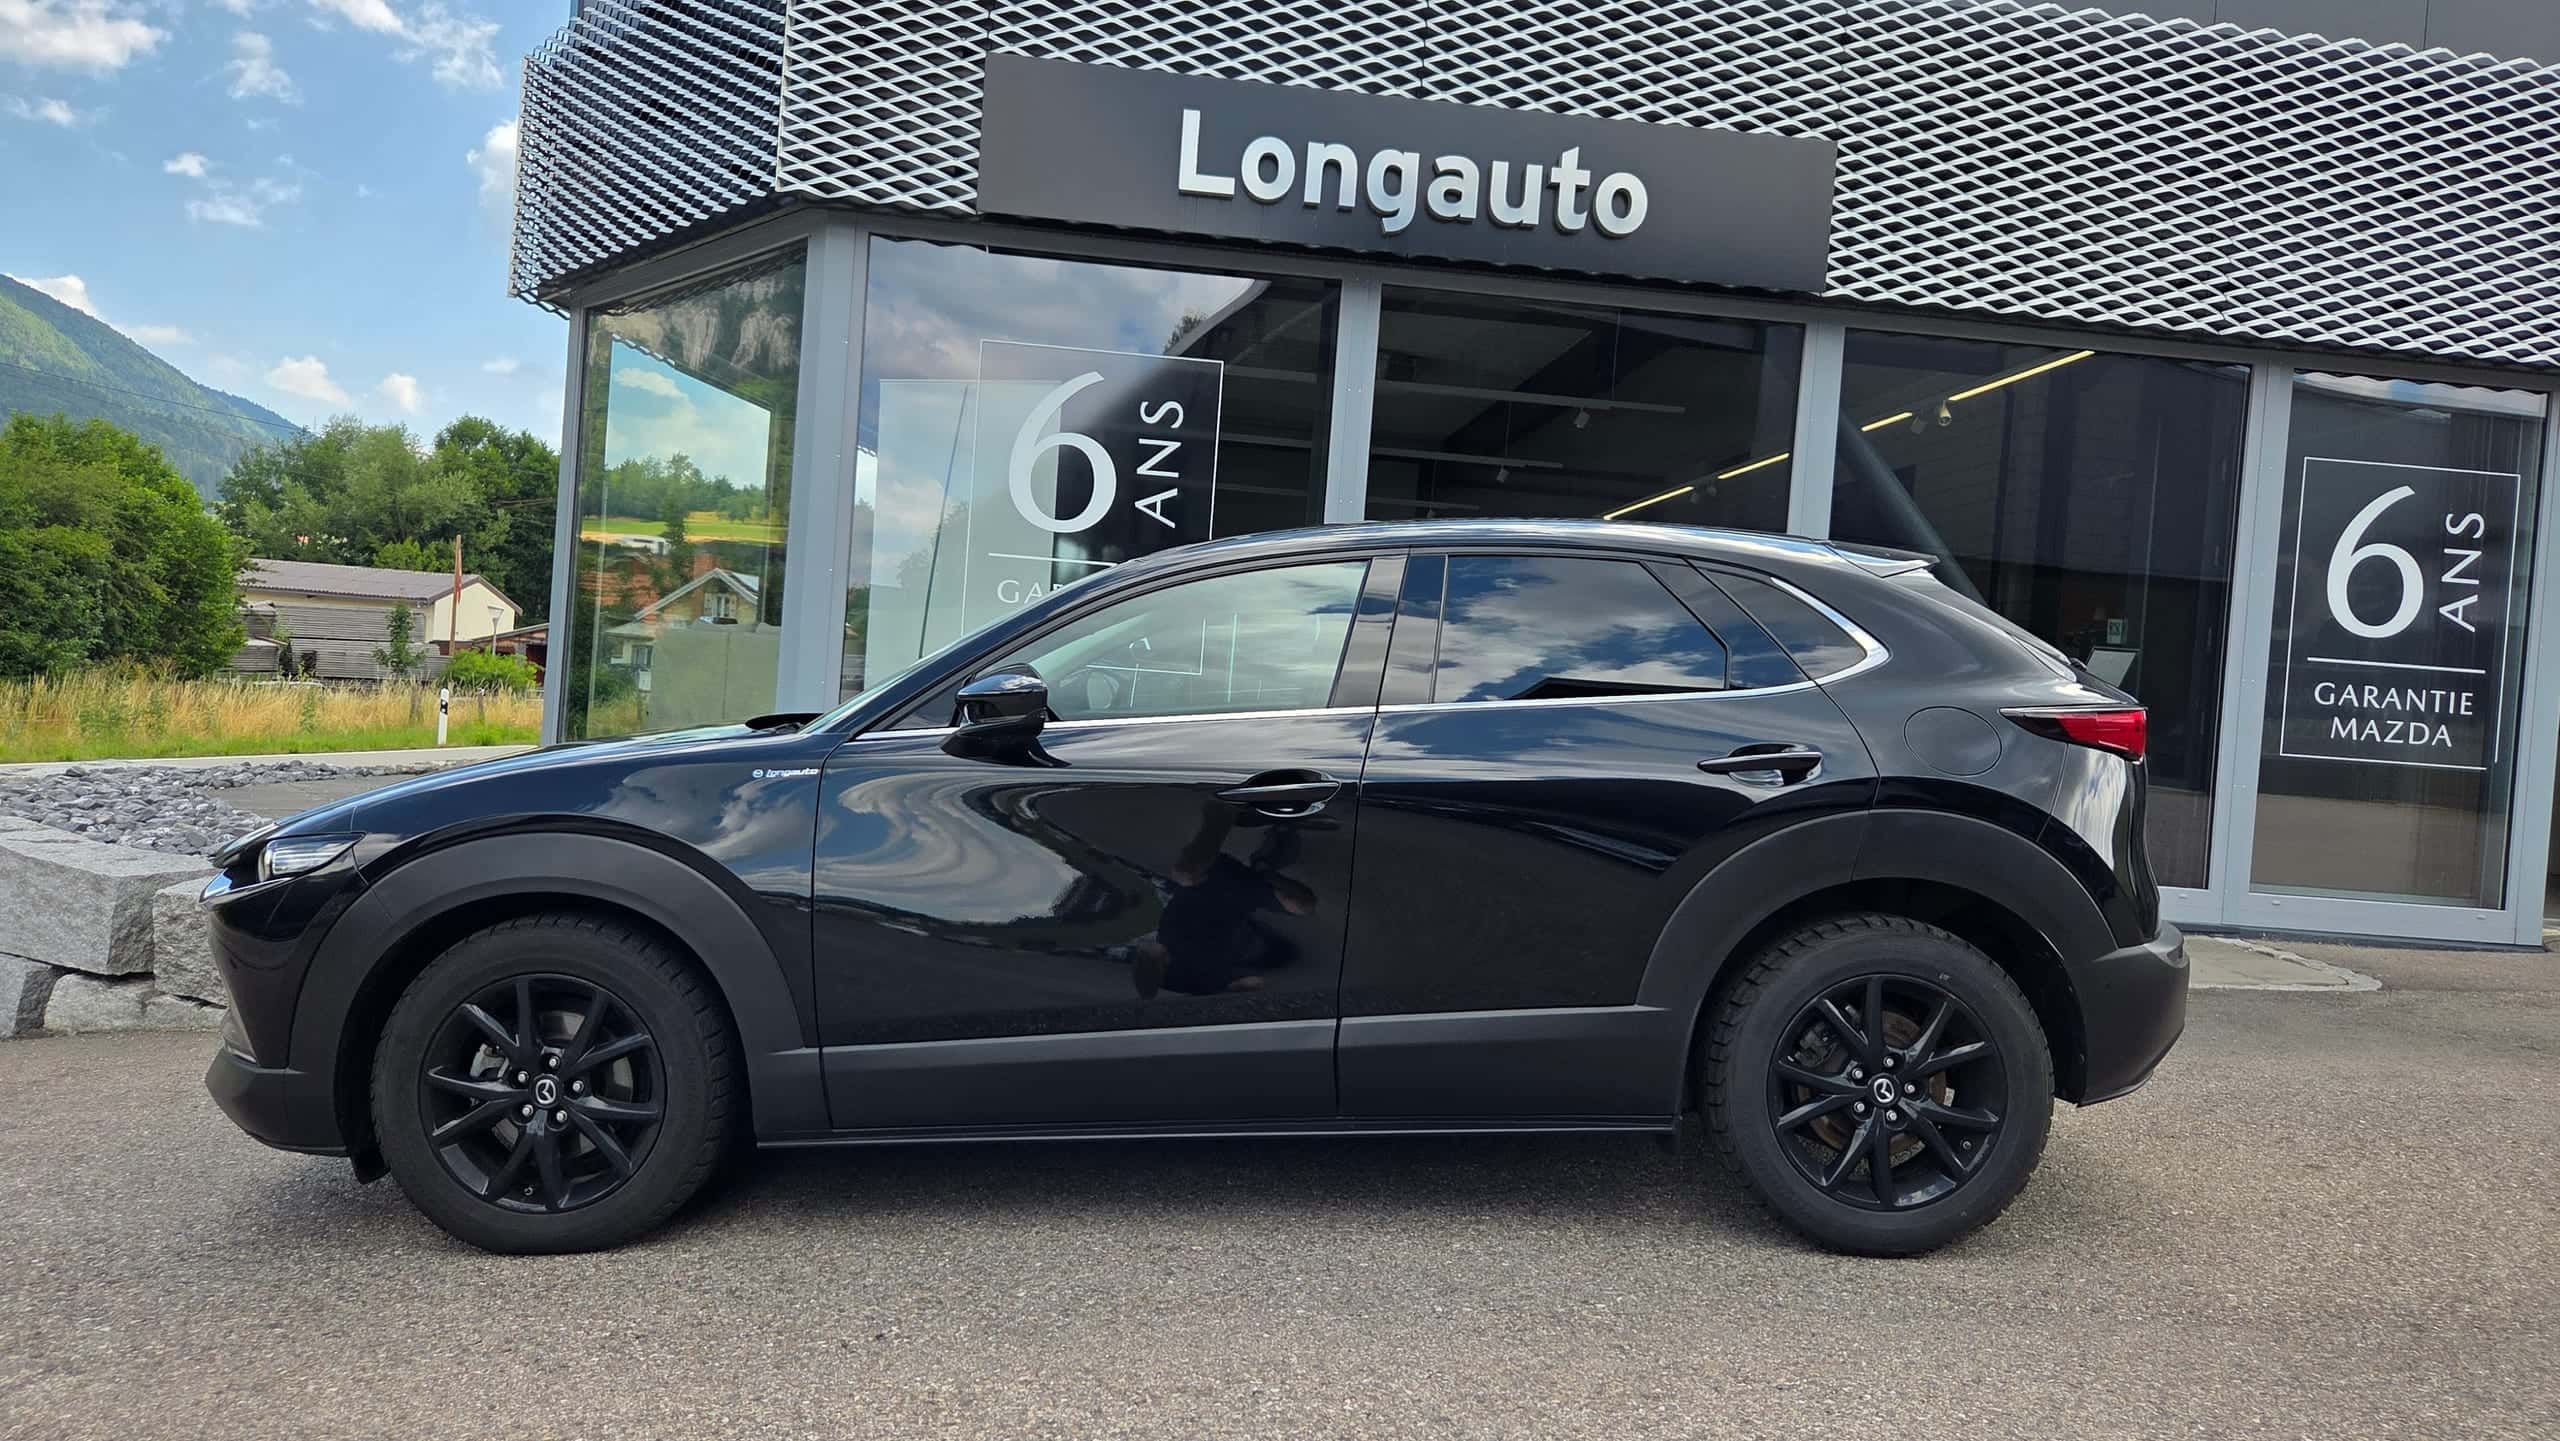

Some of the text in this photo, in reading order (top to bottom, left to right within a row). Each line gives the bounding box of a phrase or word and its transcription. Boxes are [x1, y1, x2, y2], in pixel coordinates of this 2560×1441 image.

[1177, 109, 1649, 236] Longauto
[1008, 371, 1184, 533] 6 ANS
[2326, 485, 2485, 639] 6 ANS
[2314, 682, 2474, 716] GARANTIE
[2330, 716, 2453, 748] MAZDA
